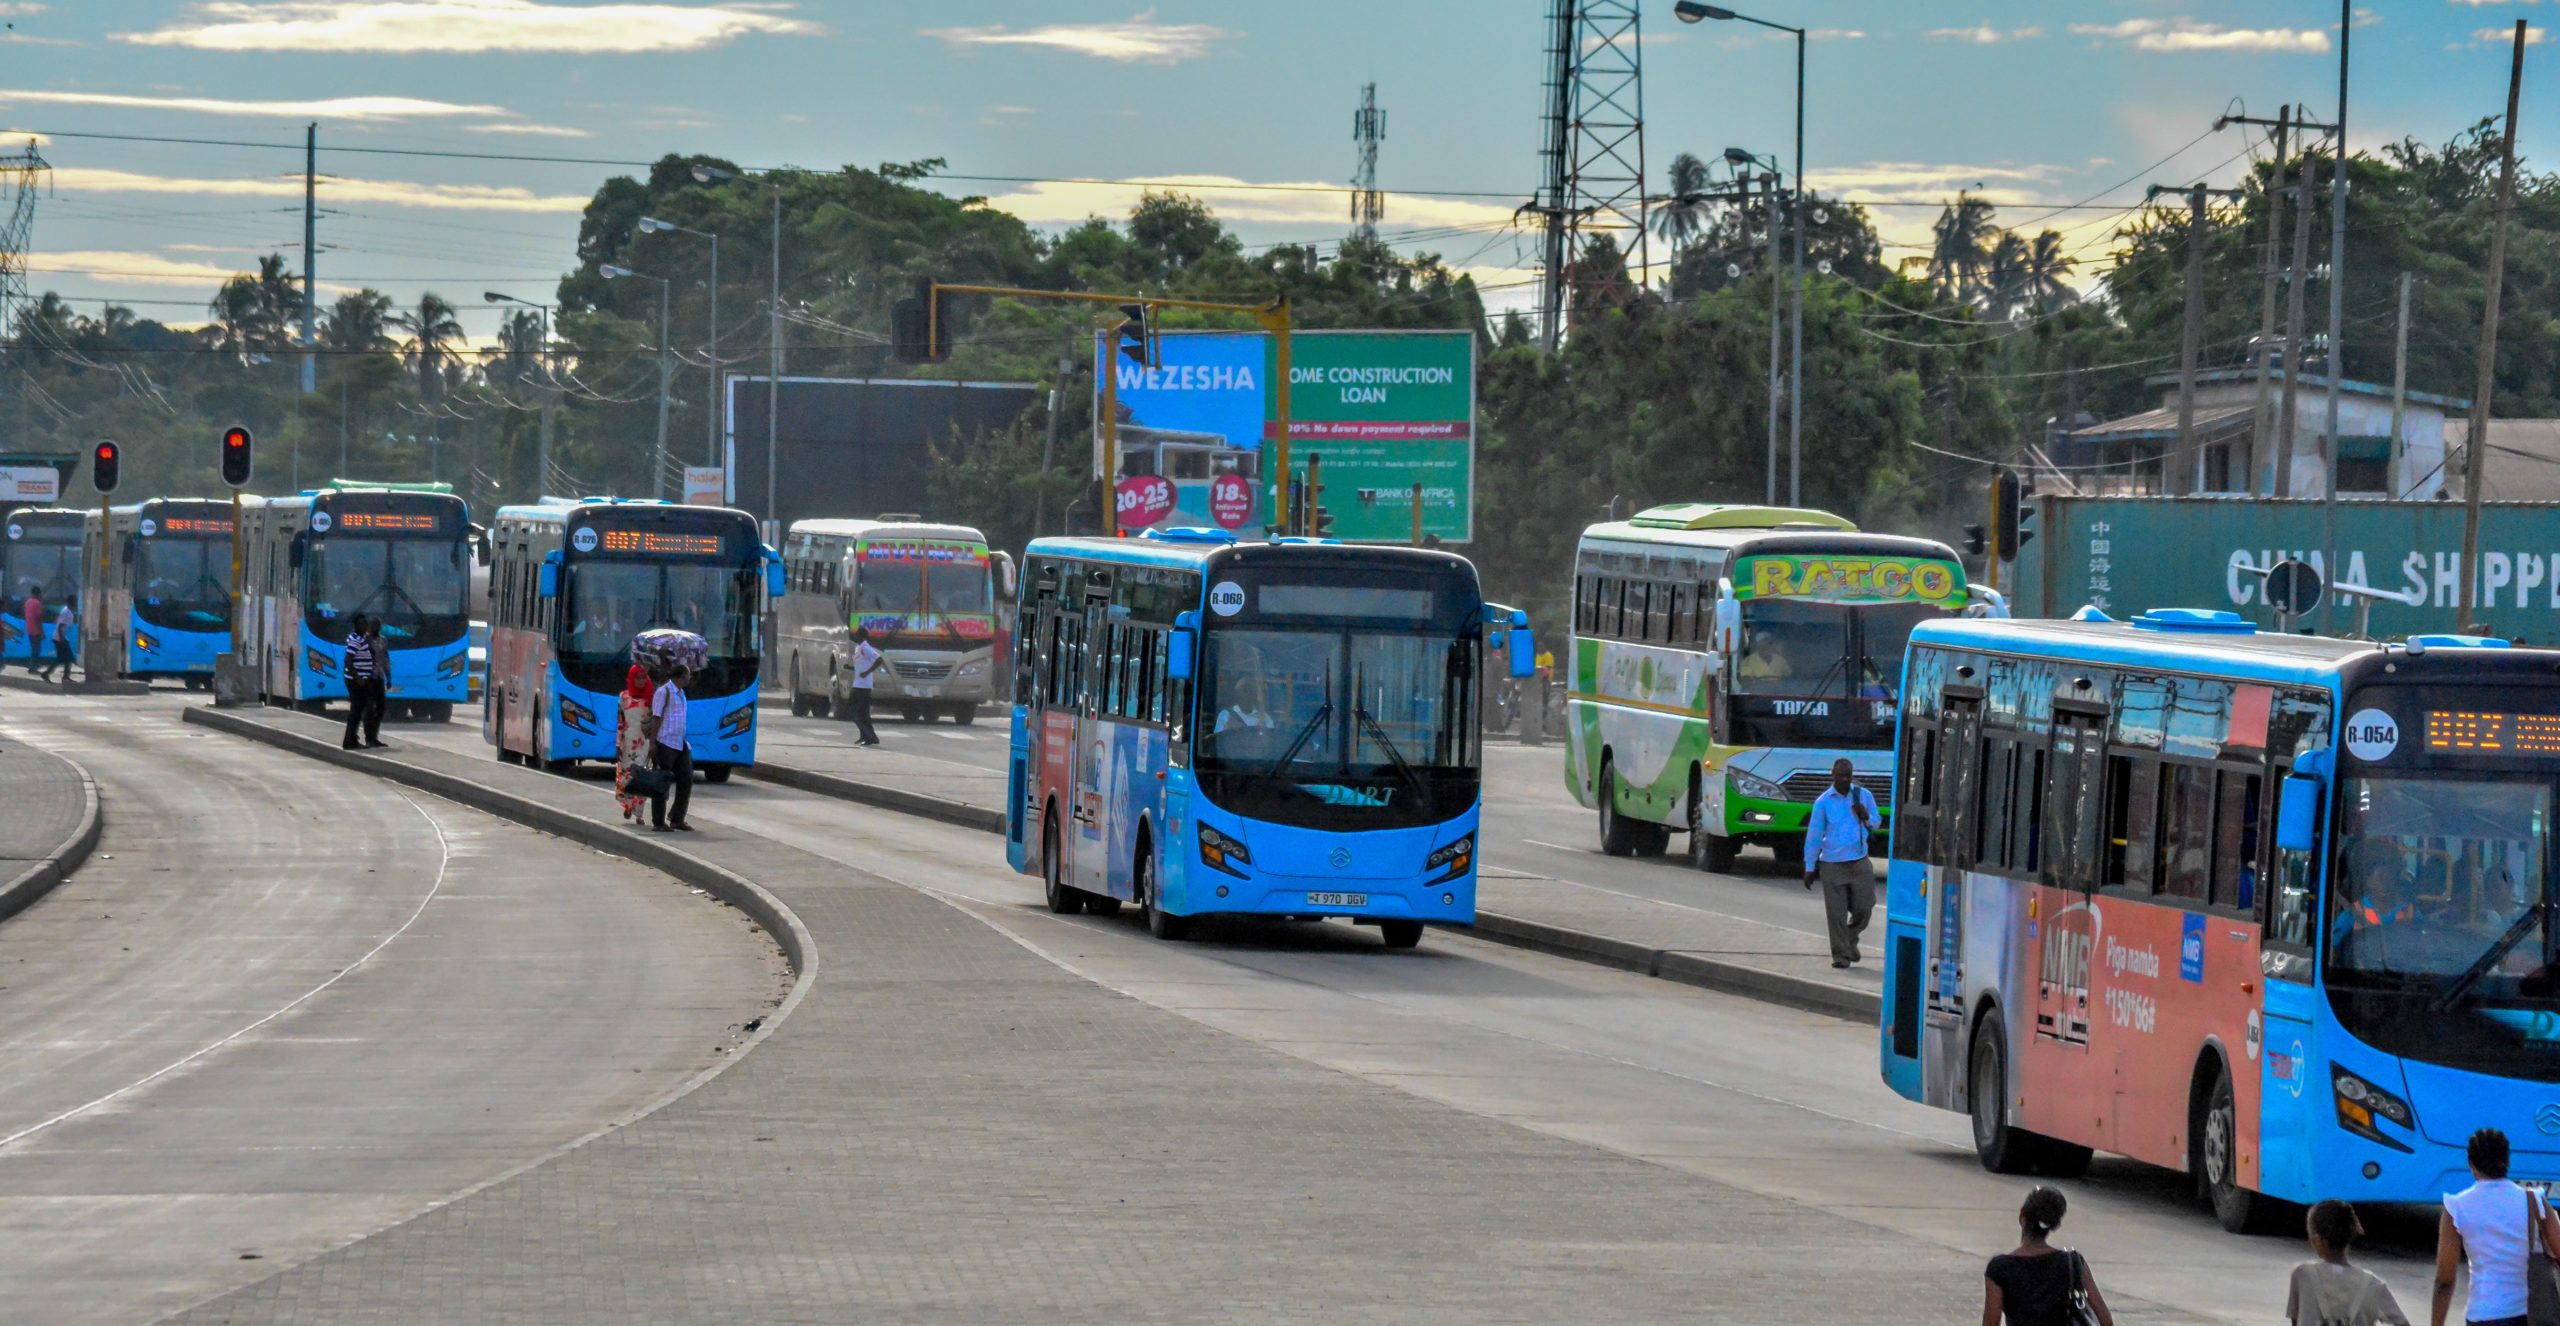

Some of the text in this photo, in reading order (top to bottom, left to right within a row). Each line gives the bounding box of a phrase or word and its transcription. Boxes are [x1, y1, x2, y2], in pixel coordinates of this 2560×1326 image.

[1116, 365, 1255, 390] WEZESHA
[1289, 367, 1452, 384] OME CONSTRUCTION
[1340, 387, 1387, 403] LOAN
[1361, 424, 1405, 435] payment
[1408, 424, 1452, 435] required
[1375, 488, 1455, 499] BANK O AFRICA
[1753, 559, 1953, 600] RATCO
[1212, 592, 1243, 605] R-068
[2348, 726, 2395, 744] R-054
[1325, 785, 1397, 807] DART
[2106, 934, 2160, 980] Piga namba
